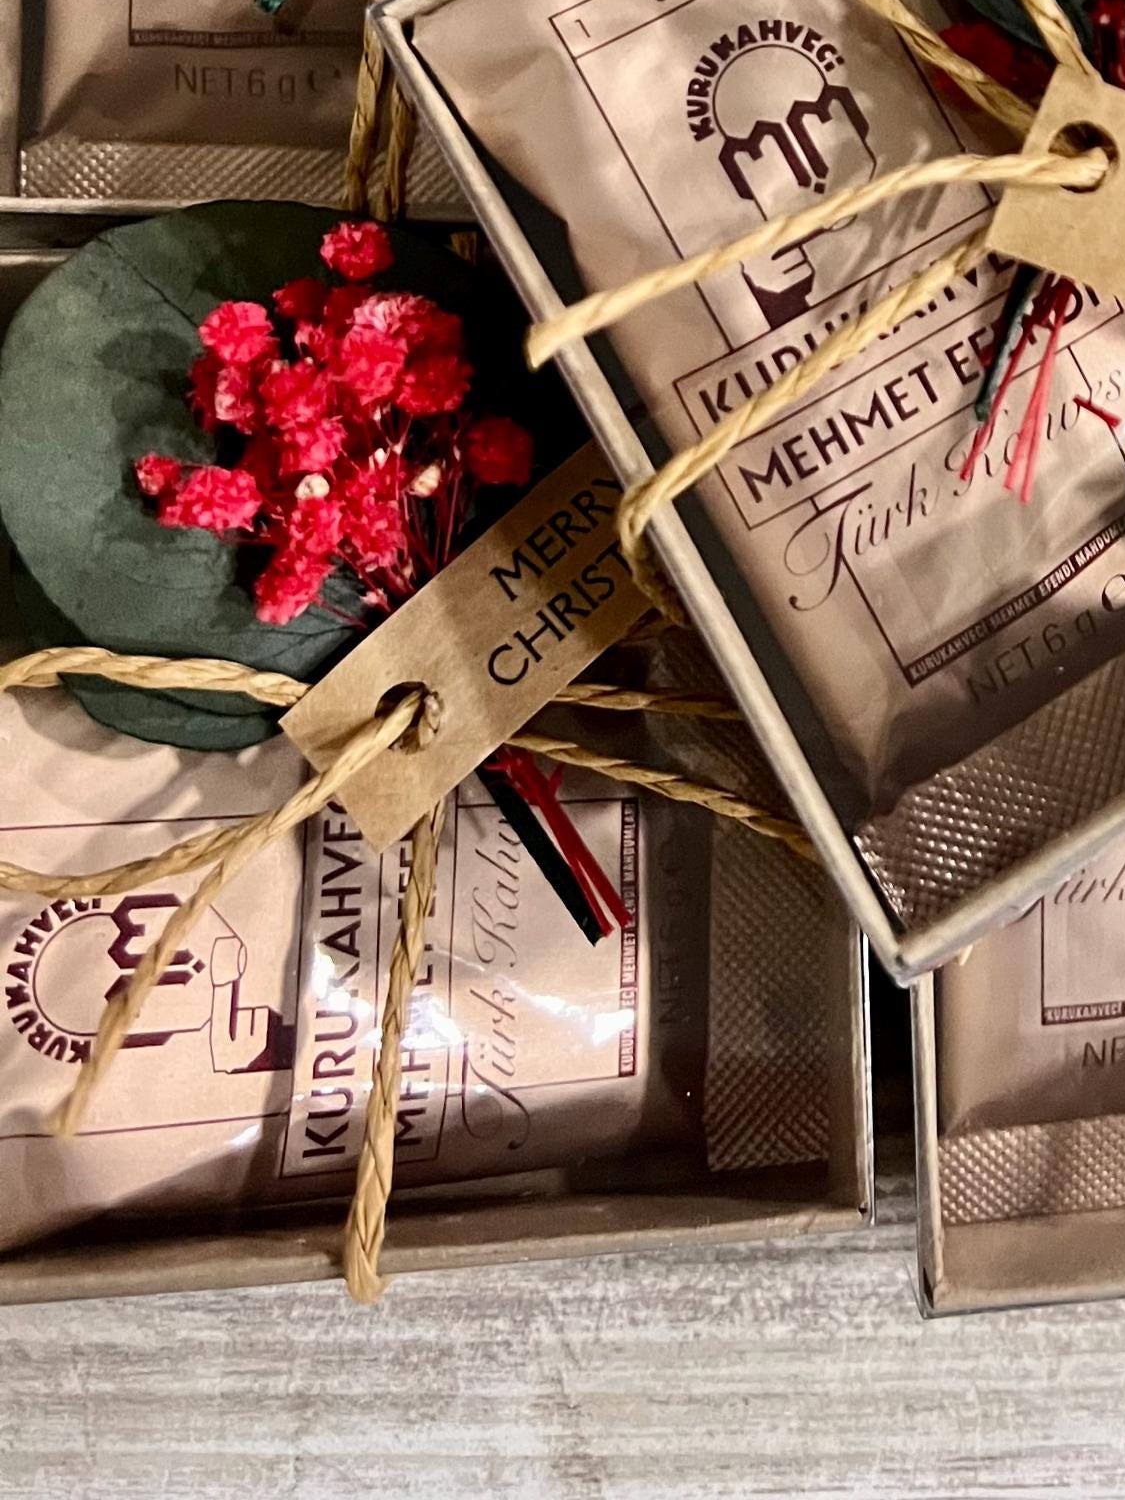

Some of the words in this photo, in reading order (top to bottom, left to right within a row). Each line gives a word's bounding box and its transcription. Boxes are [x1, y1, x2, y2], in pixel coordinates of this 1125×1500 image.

[575, 18, 592, 39] 1
[738, 362, 941, 504] MEHMET
[784, 462, 932, 612] Türk
[487, 539, 633, 686] CHRIST
[967, 636, 1035, 703] NET
[1041, 622, 1067, 655] 6
[461, 987, 531, 1151] Türk
